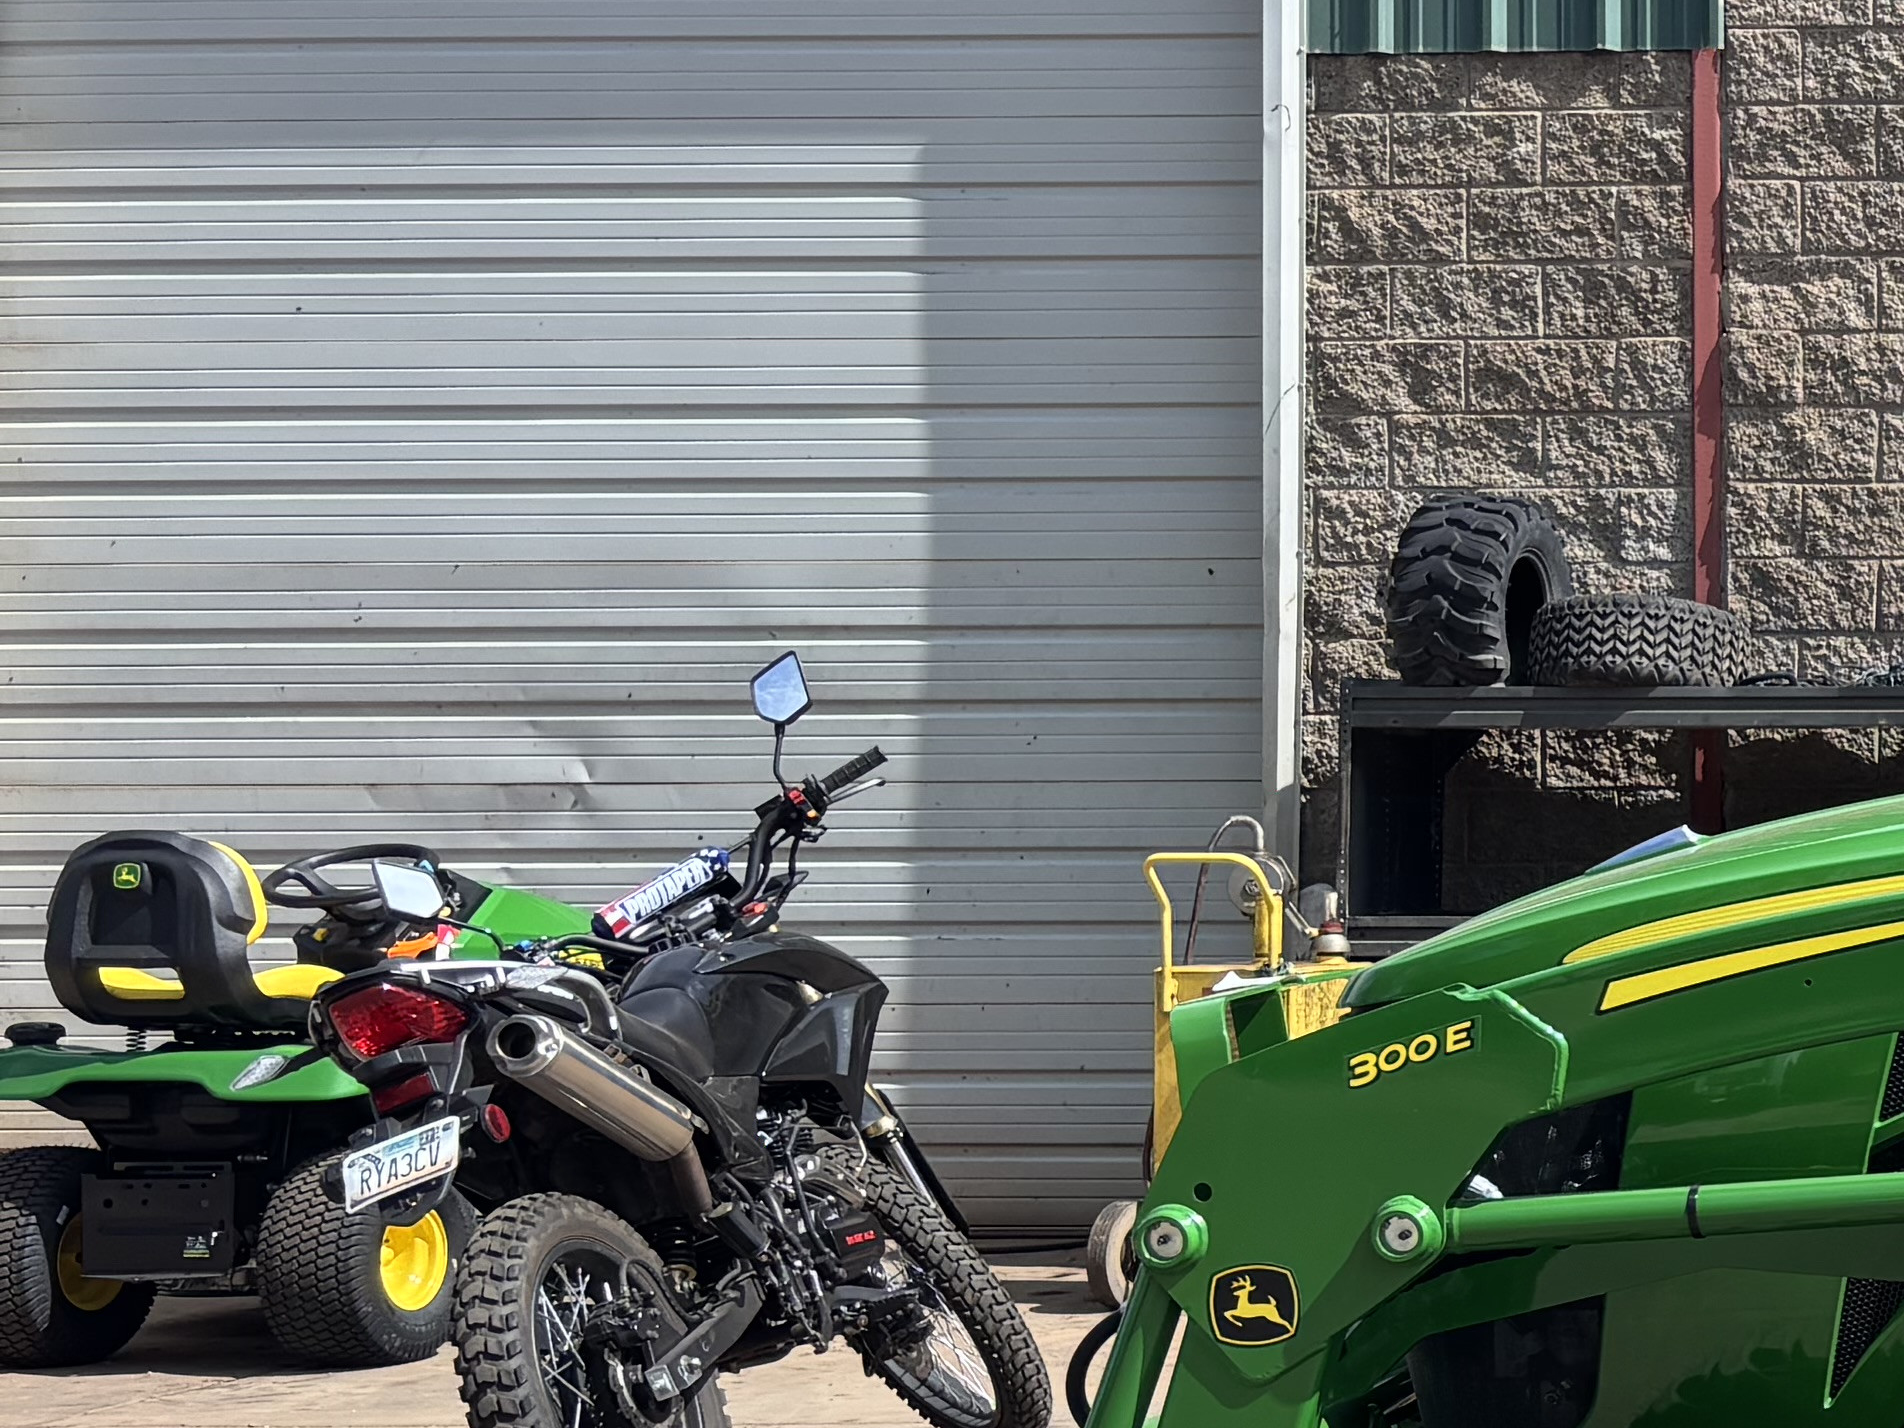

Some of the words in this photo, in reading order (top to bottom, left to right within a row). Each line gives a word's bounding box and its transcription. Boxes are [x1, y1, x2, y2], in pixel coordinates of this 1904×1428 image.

[620, 859, 710, 924] PROTAPER
[1348, 1033, 1438, 1089] 300
[1444, 1020, 1474, 1054] E
[360, 1140, 441, 1196] RYA3CV
